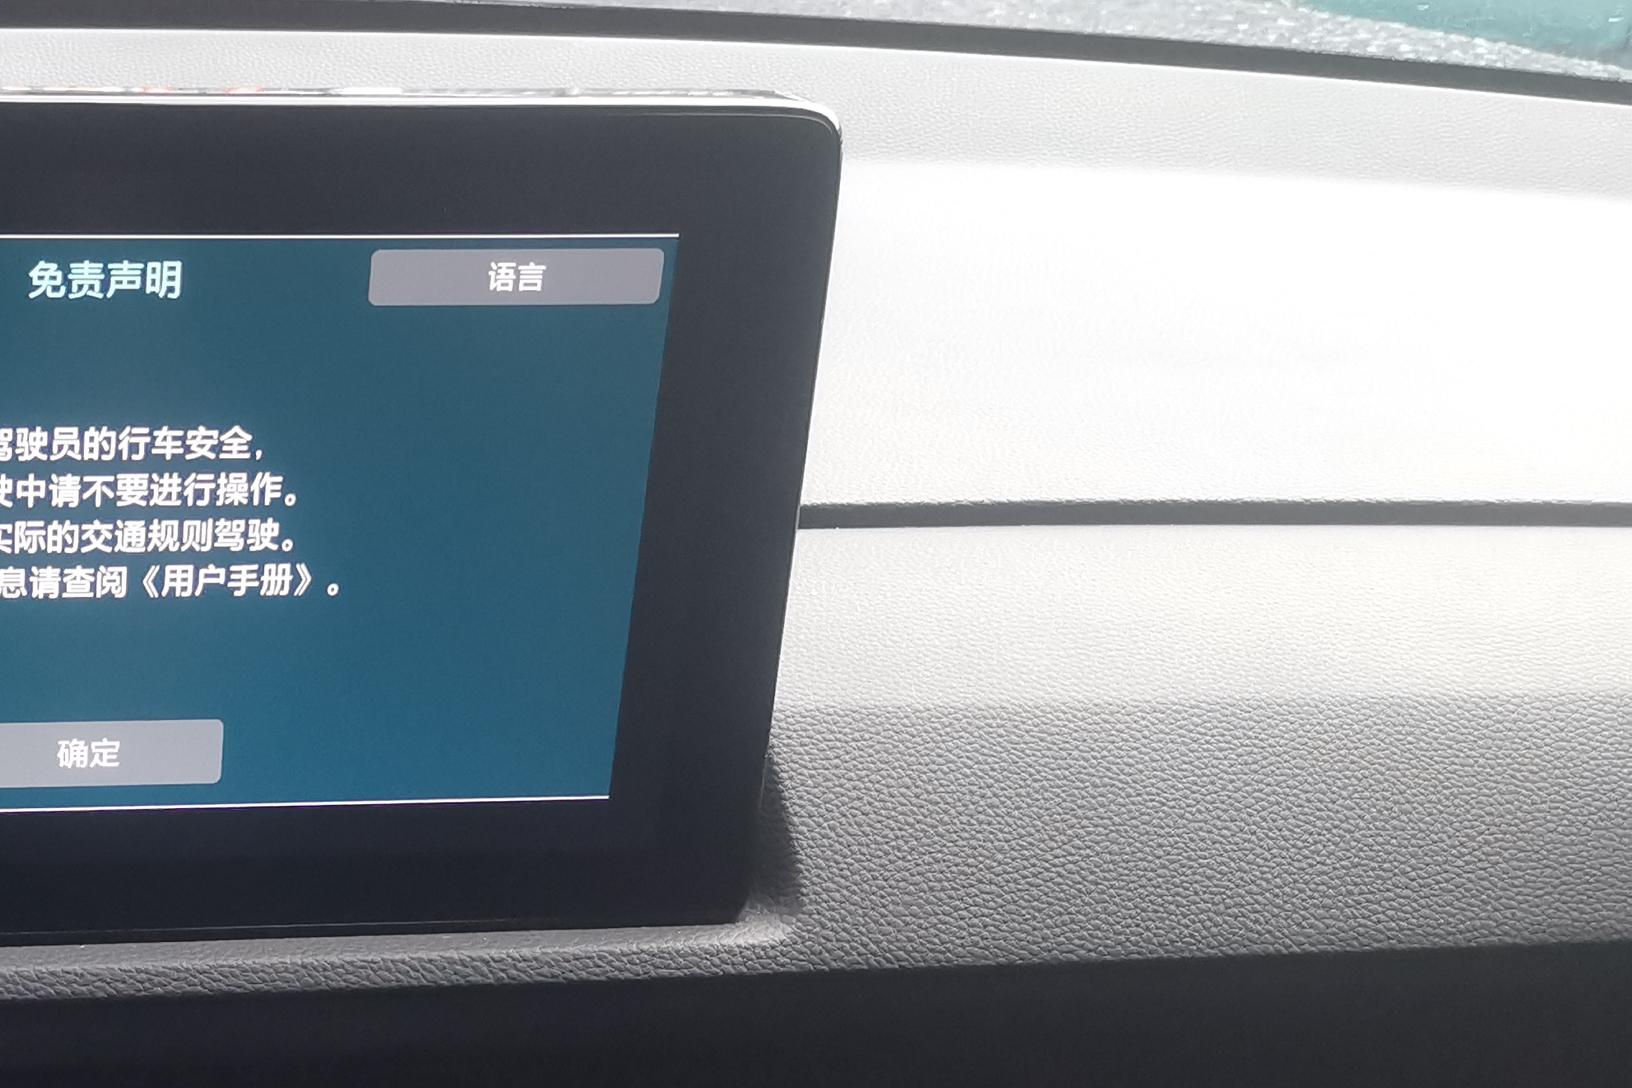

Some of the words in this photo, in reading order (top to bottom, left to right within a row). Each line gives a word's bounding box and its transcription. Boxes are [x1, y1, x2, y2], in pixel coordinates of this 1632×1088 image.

[28, 259, 183, 300] 免责声明
[487, 261, 548, 292] 语言
[56, 736, 121, 769] 确定
